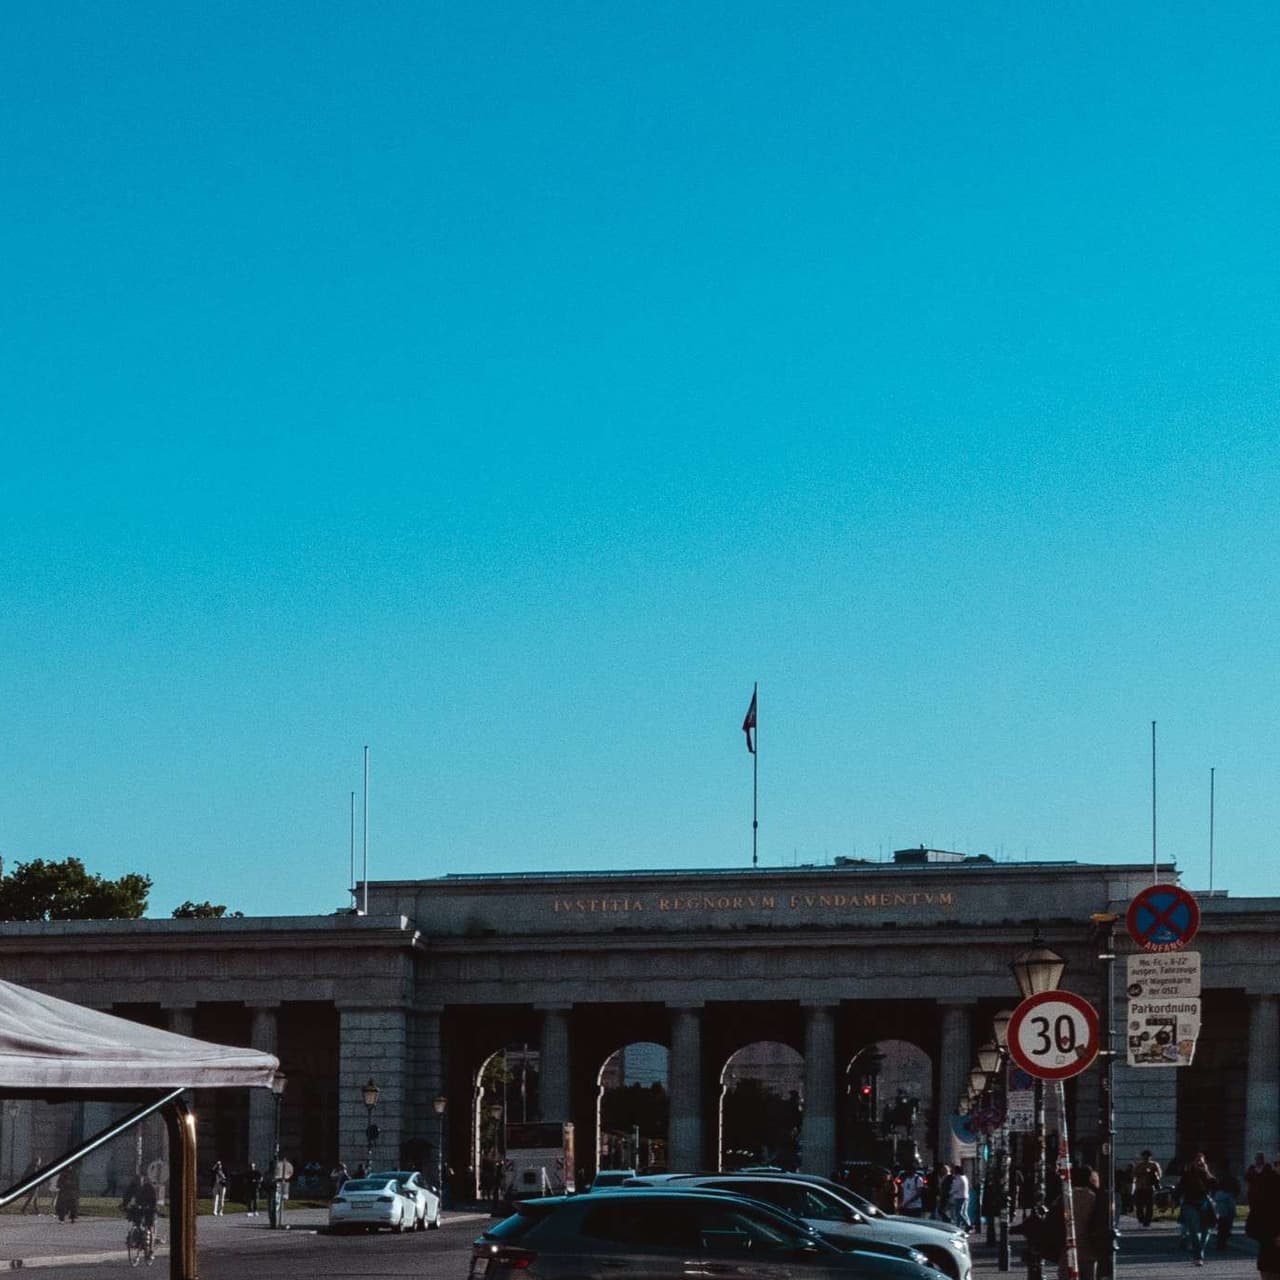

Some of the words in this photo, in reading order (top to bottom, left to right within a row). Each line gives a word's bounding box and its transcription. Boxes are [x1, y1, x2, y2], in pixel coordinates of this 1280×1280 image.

[554, 898, 643, 912] IVSTITIA
[659, 895, 775, 912] REGNORVM
[790, 893, 952, 908] FVNDAMENTVM
[1143, 939, 1184, 953] ANFANG
[1131, 1002, 1198, 1015] Parkordnung
[1030, 1014, 1076, 1055] 30
